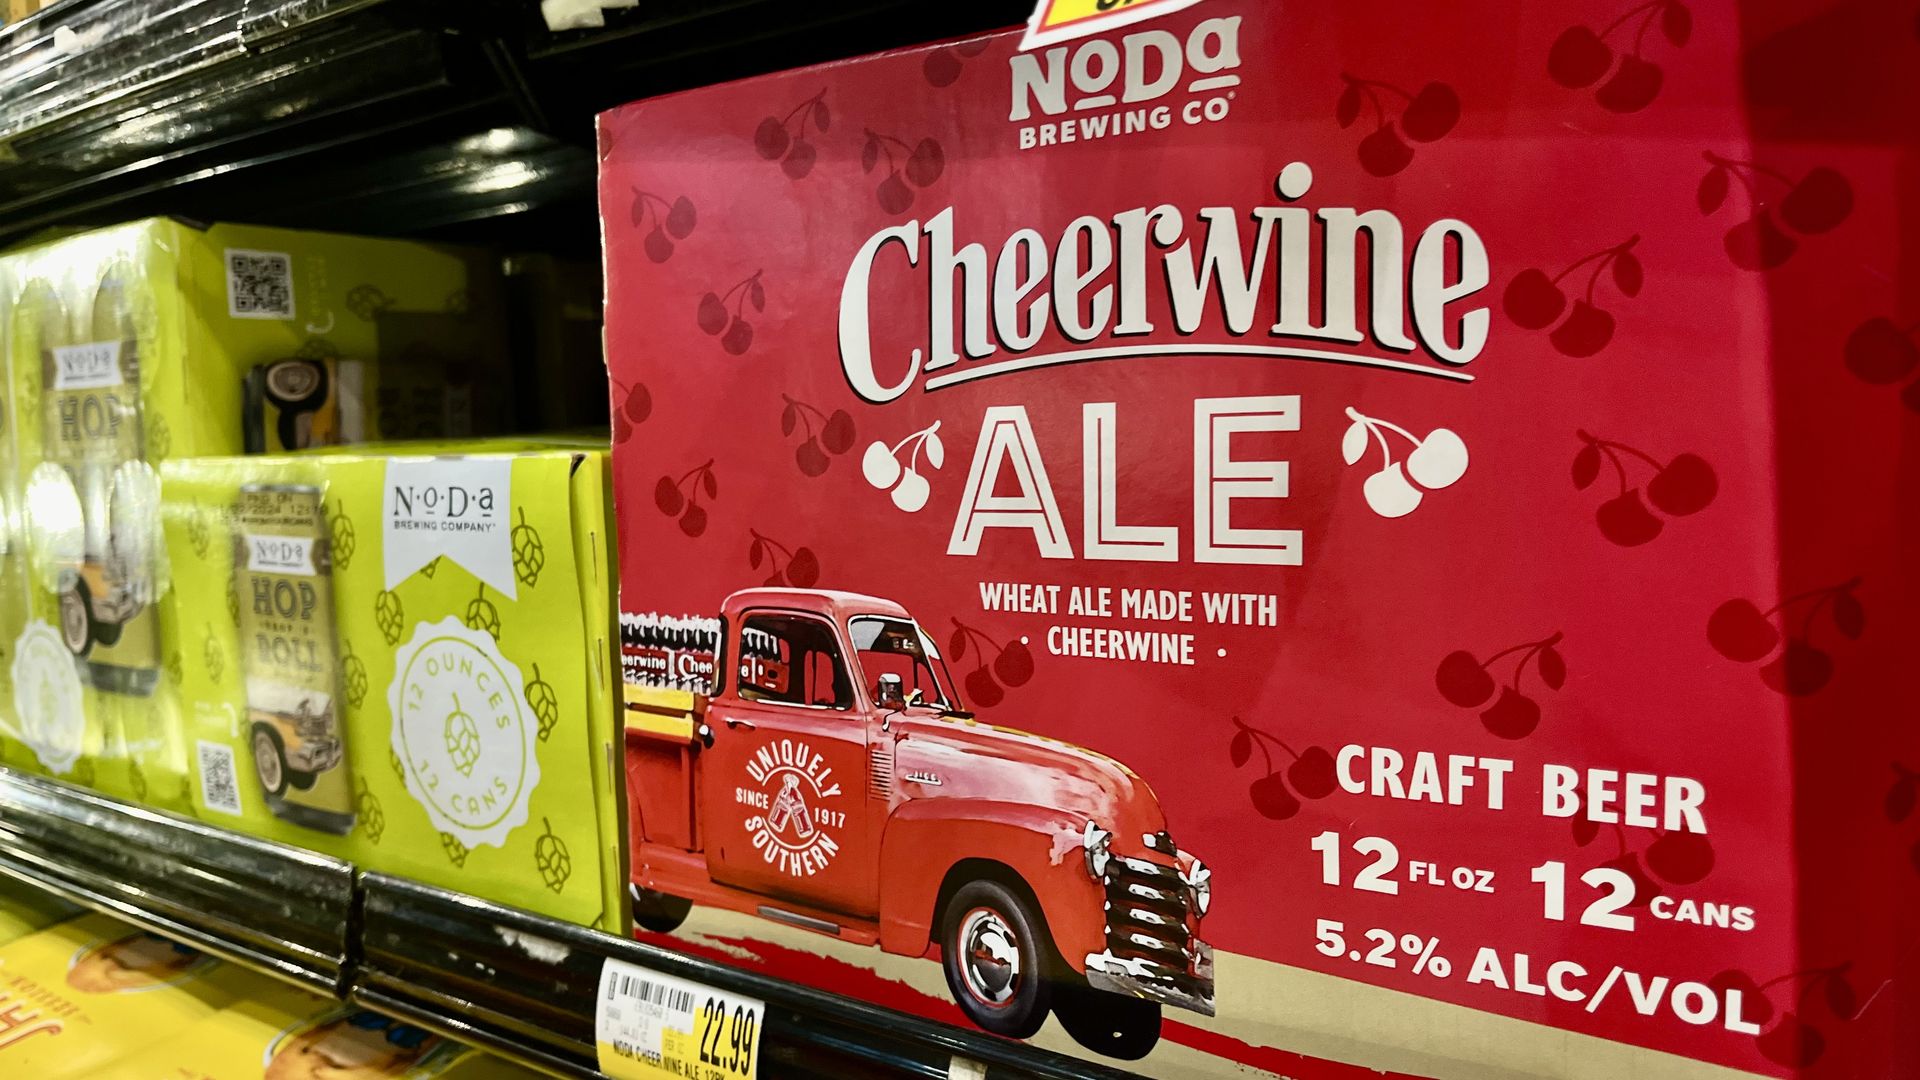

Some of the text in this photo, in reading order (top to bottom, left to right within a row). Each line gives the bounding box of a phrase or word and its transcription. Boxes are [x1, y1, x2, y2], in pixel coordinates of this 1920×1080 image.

[1019, 106, 1171, 149] BREWING
[837, 162, 1490, 403] Cheerwine
[946, 394, 1303, 566] ALE
[394, 520, 492, 533] BREWING COMPANY
[251, 576, 317, 620] HOP
[979, 582, 1278, 627] WHEAT ALE MADE WITH
[622, 652, 666, 670] eerwine
[678, 654, 713, 680] Chee
[1047, 625, 1195, 665] CHEERWINE
[426, 653, 510, 730] OUNCES
[746, 739, 841, 797] UNIQUELY
[1335, 743, 1708, 834] CRAFT BEER
[452, 776, 508, 815] CANS
[736, 787, 769, 809] SINCE
[815, 807, 845, 828] 1917
[745, 816, 839, 876] SOUTHERN
[1310, 830, 1495, 895] 12 FL OZ
[1530, 861, 1755, 931] 12 CANS
[1315, 918, 1761, 1035] 5.2% ALC/VOL
[613, 1039, 634, 1058] NODA
[685, 1062, 699, 1080] ALE
[700, 997, 754, 1077] 22.99
